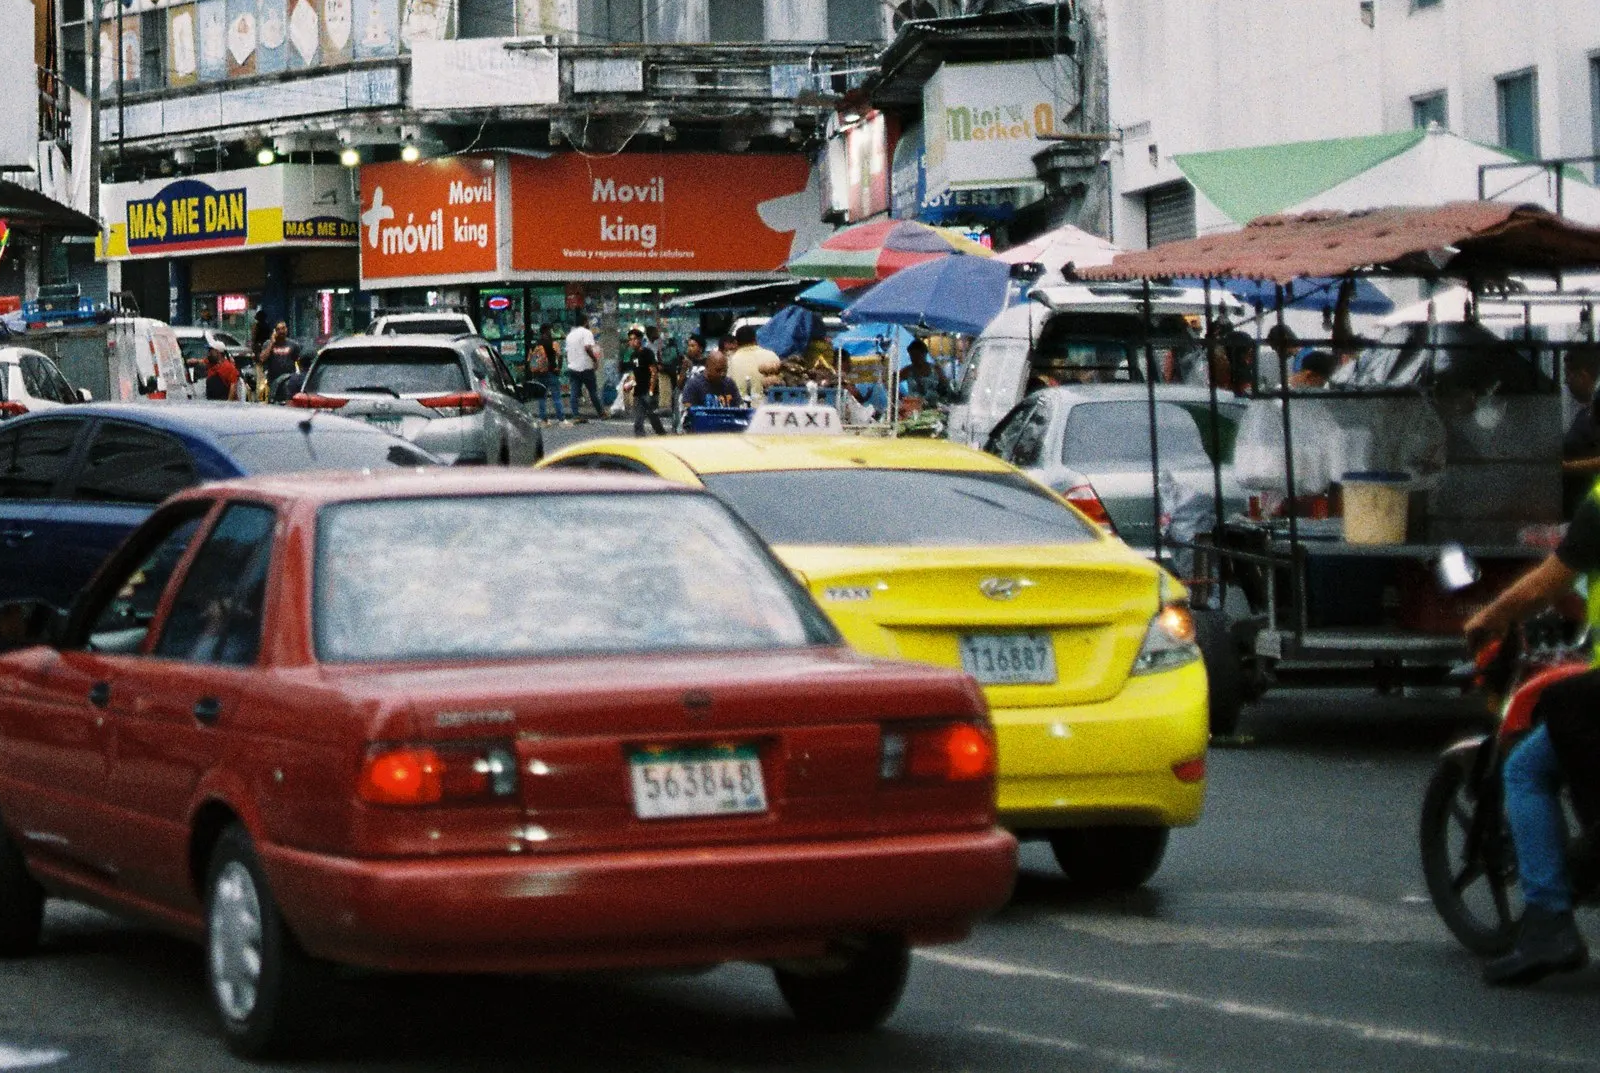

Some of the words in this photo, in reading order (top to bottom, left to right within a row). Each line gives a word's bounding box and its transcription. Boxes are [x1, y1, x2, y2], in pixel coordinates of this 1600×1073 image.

[448, 176, 492, 205] Movil
[591, 176, 665, 203] Movil
[172, 197, 200, 236] ME
[204, 192, 245, 234] DAN
[317, 221, 337, 236] ME
[453, 216, 488, 248] king
[600, 214, 657, 248] king
[766, 411, 831, 428] TAXI
[827, 587, 872, 601] TAXI
